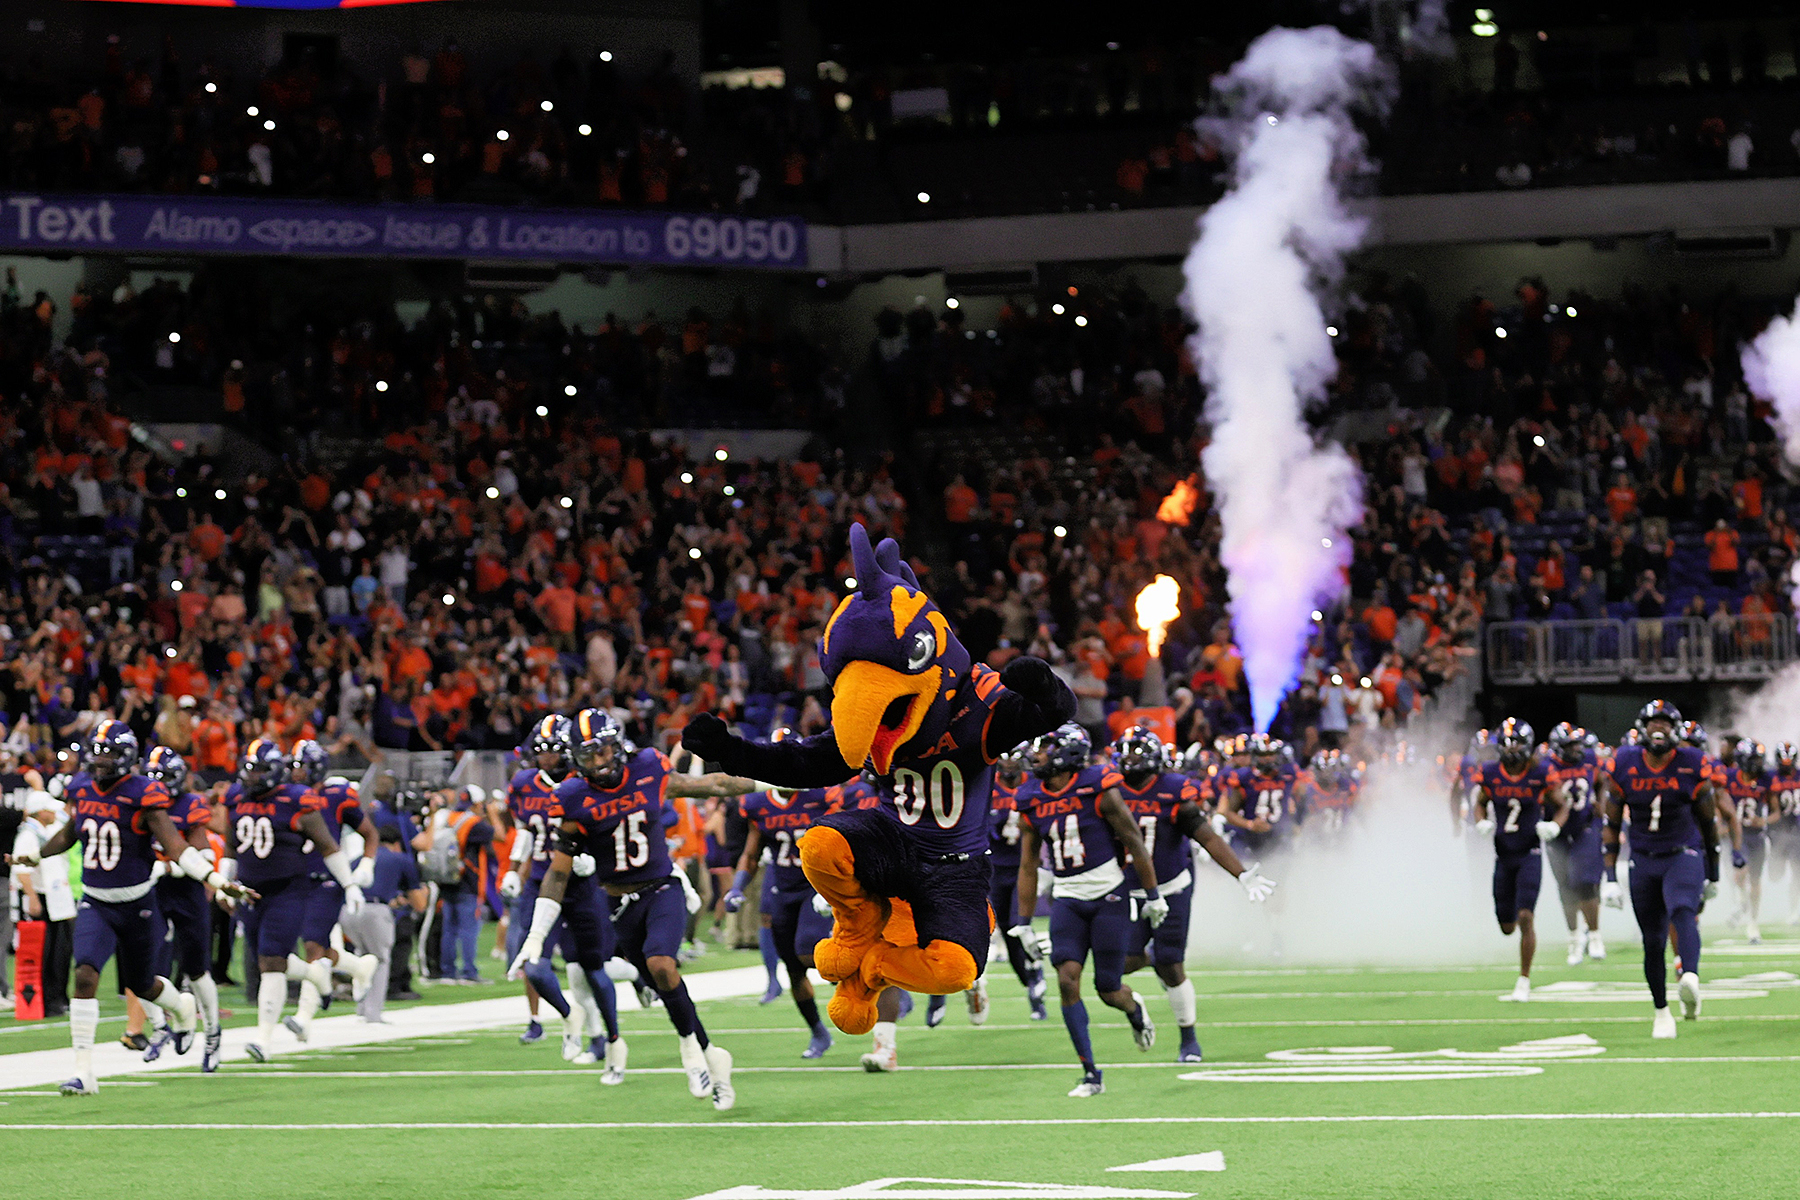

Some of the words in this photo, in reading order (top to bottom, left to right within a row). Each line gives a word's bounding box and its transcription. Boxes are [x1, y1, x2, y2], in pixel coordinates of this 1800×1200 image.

[8, 196, 116, 242] Text
[144, 207, 243, 243] Alamo
[248, 218, 376, 253] <space>
[383, 215, 462, 249] Issue
[468, 215, 489, 250] &
[498, 217, 618, 253] Location
[623, 225, 651, 254] to
[665, 217, 797, 260] 69050
[893, 759, 966, 830] 00
[1495, 786, 1534, 798] UTSA
[1631, 776, 1680, 791] UTSA
[78, 800, 121, 819] UTSA
[236, 802, 277, 816] UTSA
[590, 791, 649, 821] UTSA
[765, 813, 812, 830] UTSA
[1035, 796, 1084, 818] UTSA
[1503, 797, 1522, 833] 2
[1647, 794, 1662, 833] 1
[81, 816, 122, 872] 20
[236, 815, 275, 860] 90
[611, 809, 649, 872] 15
[1048, 813, 1086, 871] 14
